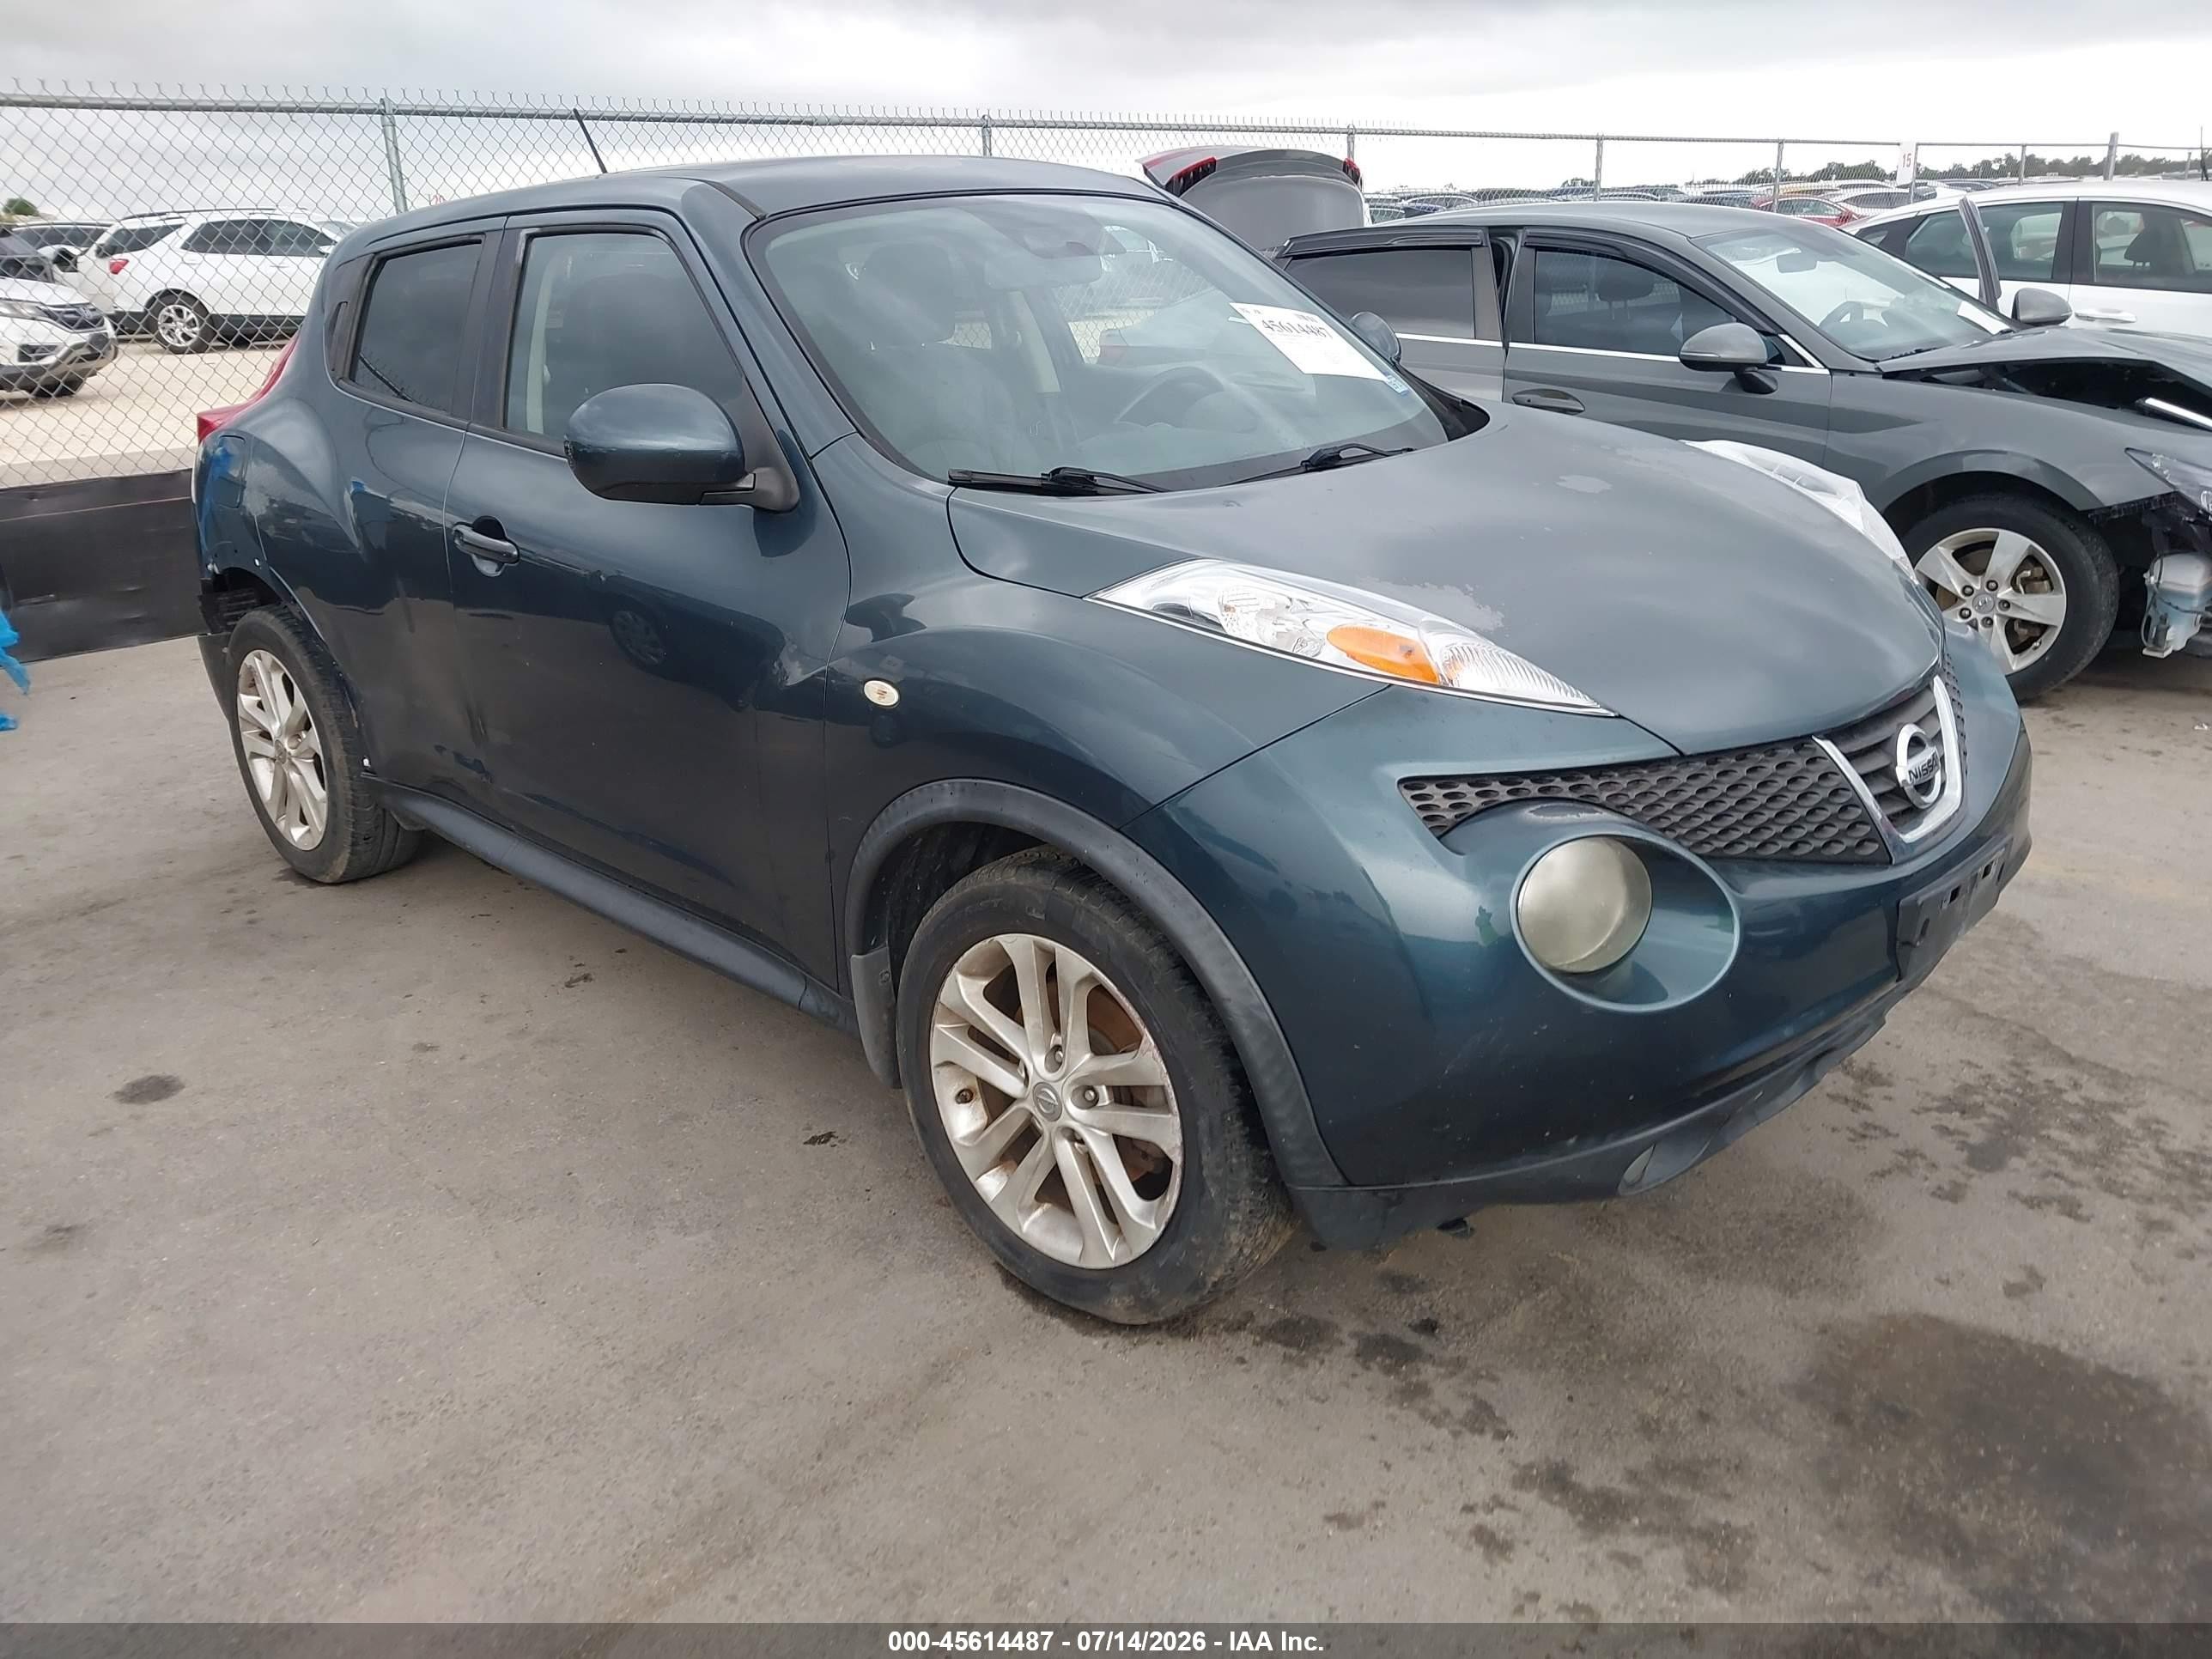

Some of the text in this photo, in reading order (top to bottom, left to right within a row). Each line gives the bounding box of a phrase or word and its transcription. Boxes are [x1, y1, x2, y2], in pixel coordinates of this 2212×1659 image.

[1902, 153, 1911, 168] 15
[1261, 319, 1333, 340] 45614487
[1908, 751, 1939, 782] NISSA
